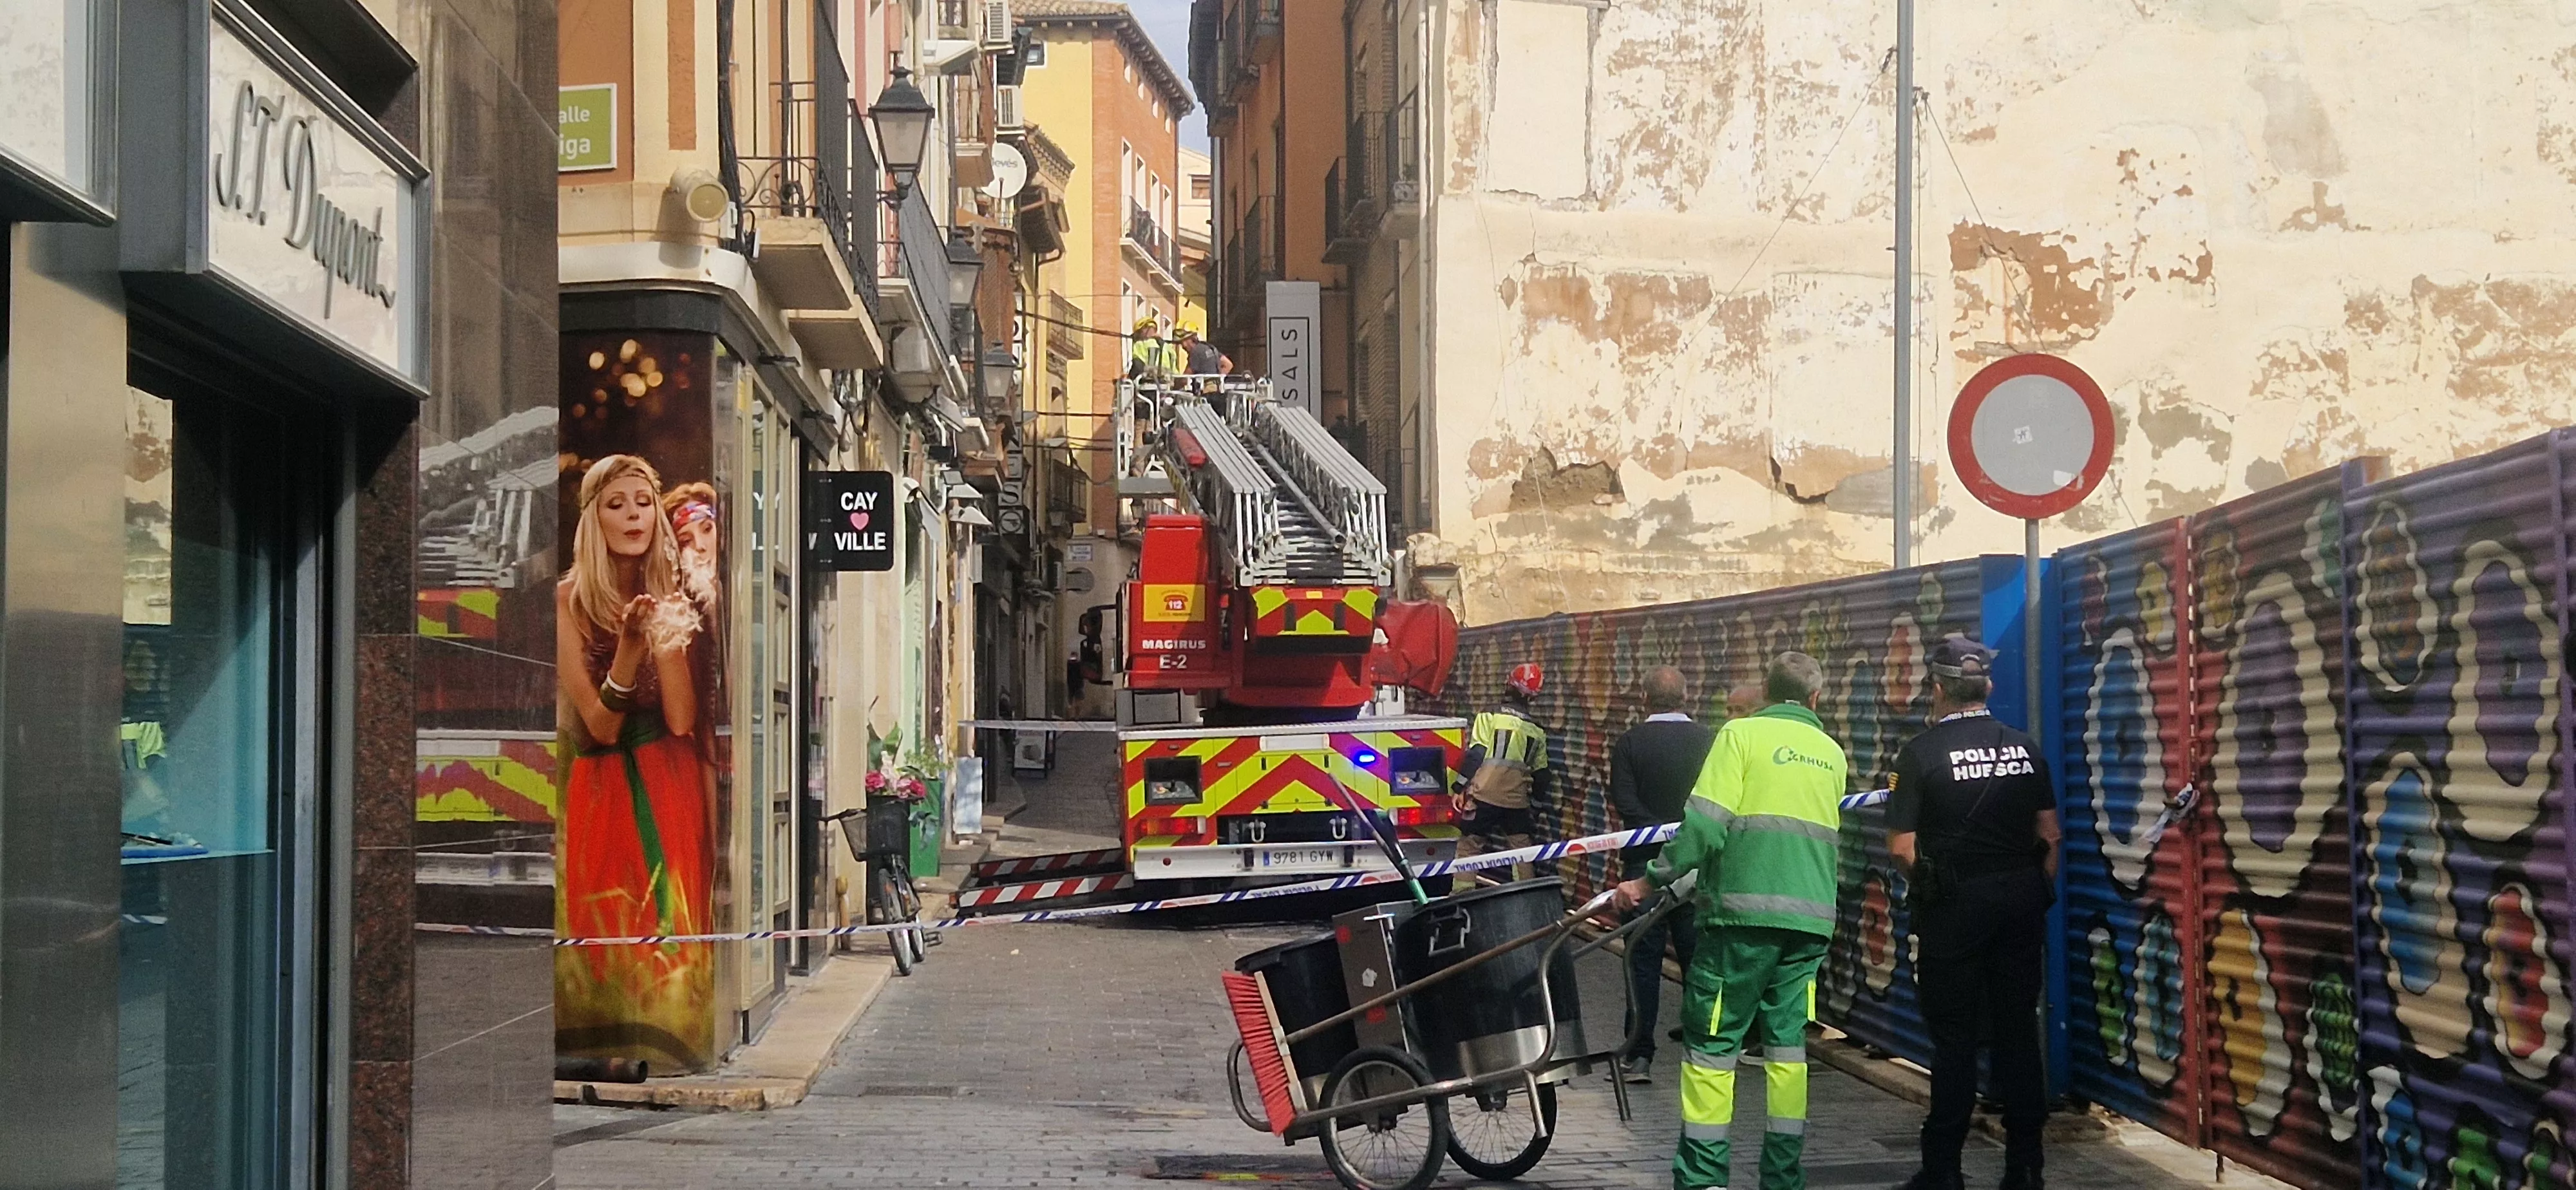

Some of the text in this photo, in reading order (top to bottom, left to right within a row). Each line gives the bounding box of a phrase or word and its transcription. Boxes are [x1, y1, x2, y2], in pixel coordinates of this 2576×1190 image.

[558, 106, 591, 124] alle
[559, 133, 591, 160] iga
[283, 115, 395, 319] Dupont
[840, 491, 878, 511] CAY
[834, 532, 887, 551] VILLE
[1142, 639, 1206, 650] MAGIRUS
[1159, 654, 1187, 669] E-2
[1949, 746, 2029, 764] POLICIA
[1274, 850, 1333, 864] 9781 GYW
